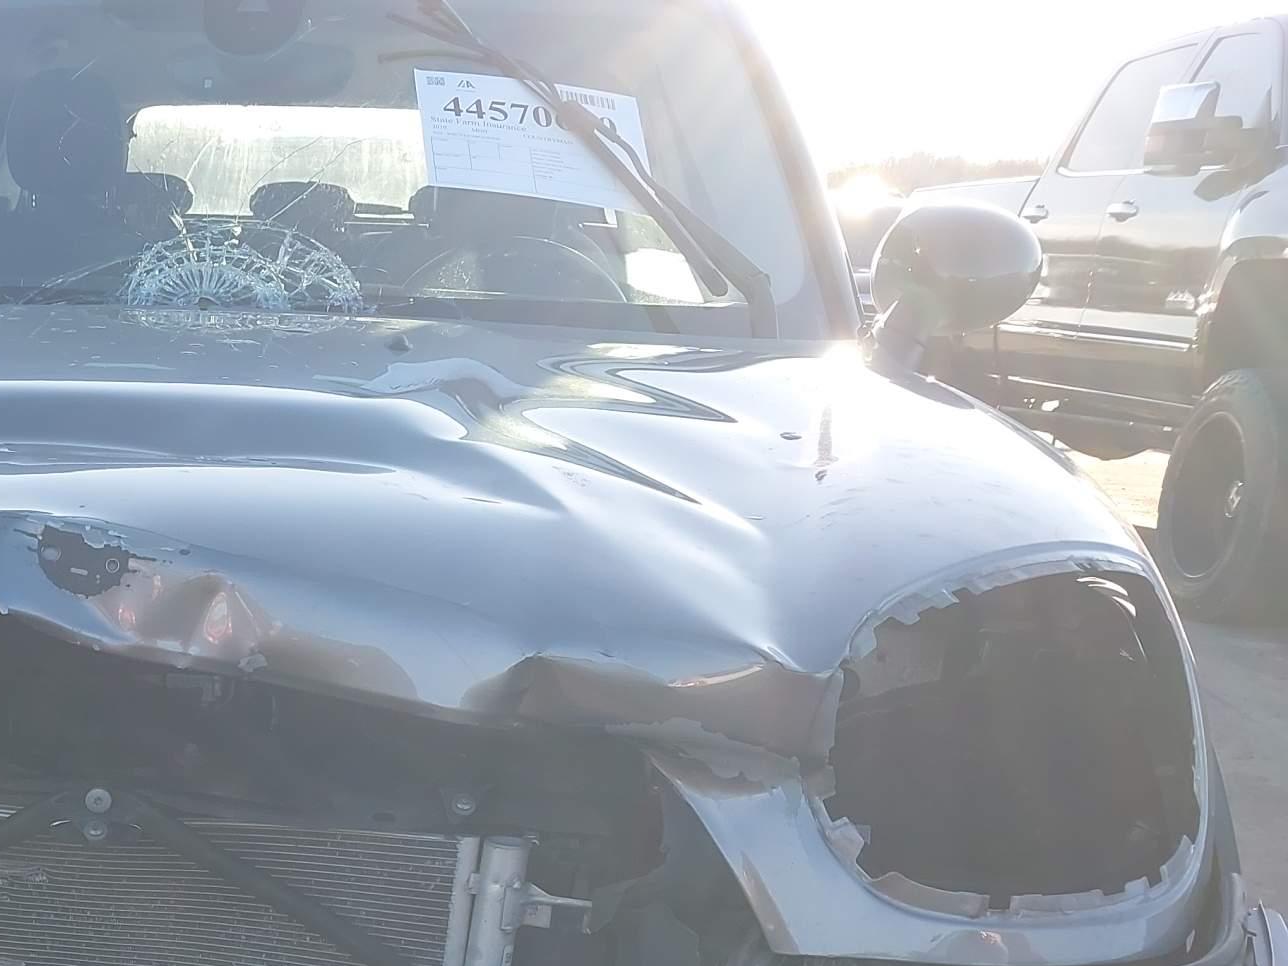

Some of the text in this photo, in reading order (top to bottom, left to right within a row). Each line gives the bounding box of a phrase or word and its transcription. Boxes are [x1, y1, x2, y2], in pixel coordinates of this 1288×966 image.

[430, 115, 527, 132] State Farm Insurance
